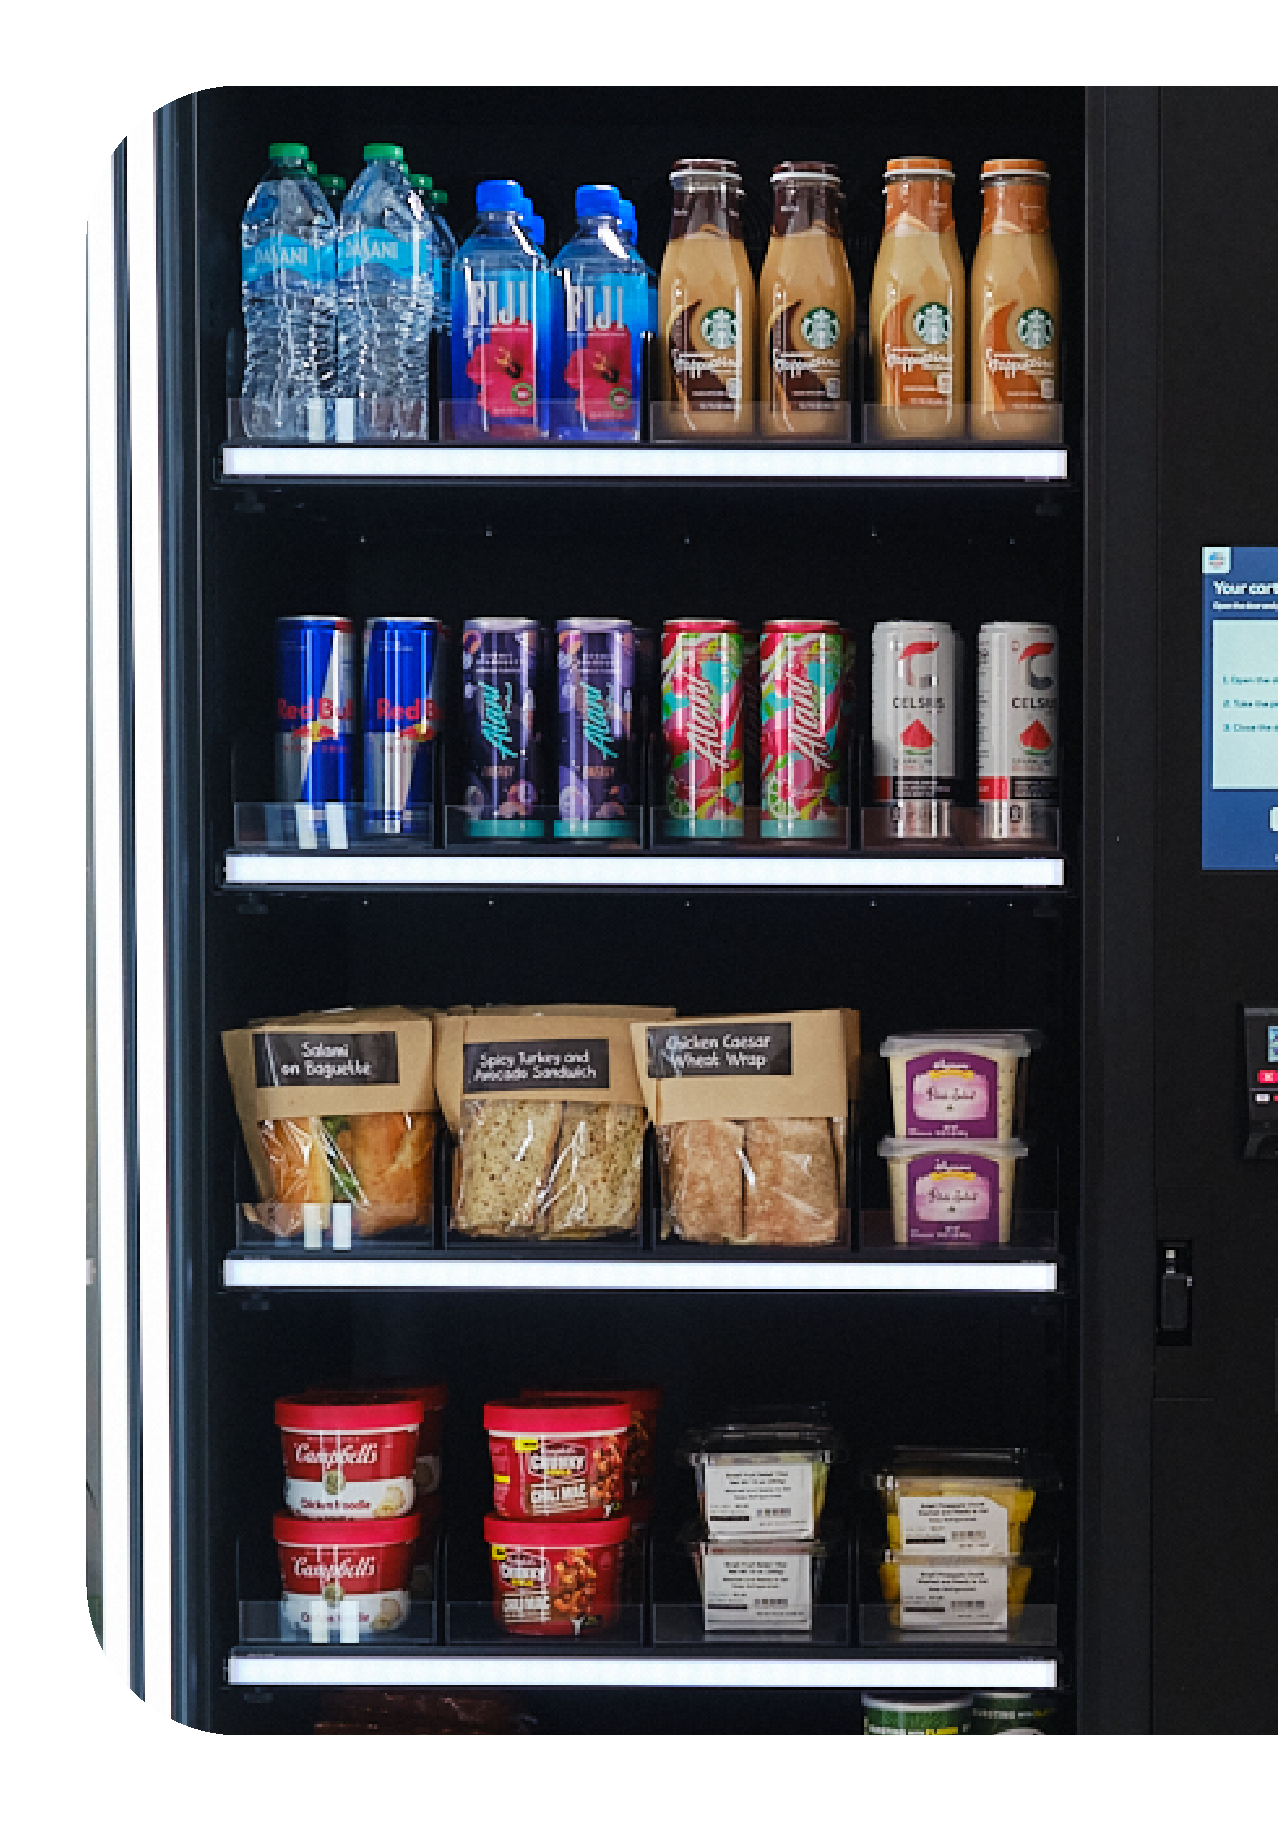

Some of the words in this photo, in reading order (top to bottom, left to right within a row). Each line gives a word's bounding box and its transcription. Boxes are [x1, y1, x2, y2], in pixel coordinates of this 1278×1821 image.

[468, 280, 529, 326] FIJI
[566, 285, 625, 332] FIJI
[1213, 580, 1247, 595] Your
[277, 696, 314, 720] Red
[375, 697, 420, 720] Red
[301, 1041, 350, 1059] Salami
[665, 1034, 719, 1050] Chicken
[722, 1033, 772, 1050] Caesar
[517, 1051, 562, 1067] Turkey
[563, 1047, 590, 1064] and
[725, 1049, 768, 1070] Wrap
[281, 1062, 301, 1077] on
[304, 1059, 373, 1080] Baguette
[531, 1063, 597, 1080] Sandwich
[294, 1441, 379, 1469] Campbell's
[292, 1554, 376, 1581] Campbell's
